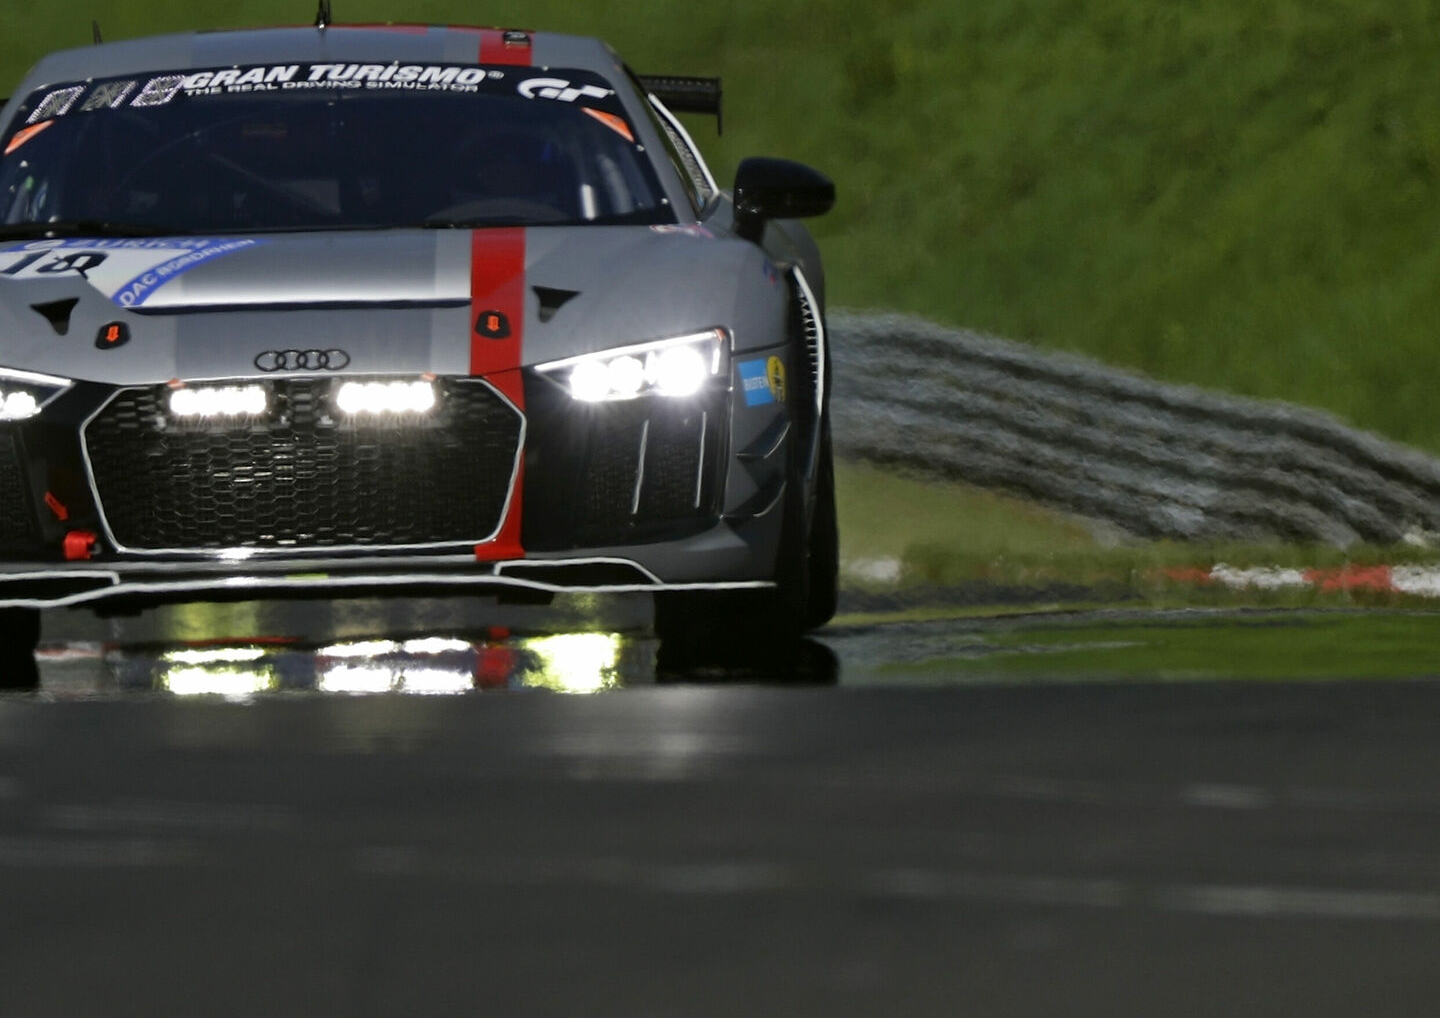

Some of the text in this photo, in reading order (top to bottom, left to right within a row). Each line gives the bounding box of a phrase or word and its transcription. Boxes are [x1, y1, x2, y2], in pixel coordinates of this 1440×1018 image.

[183, 65, 300, 89] GRAN
[184, 80, 478, 96] THE REAL DRIVING SIMULATOR
